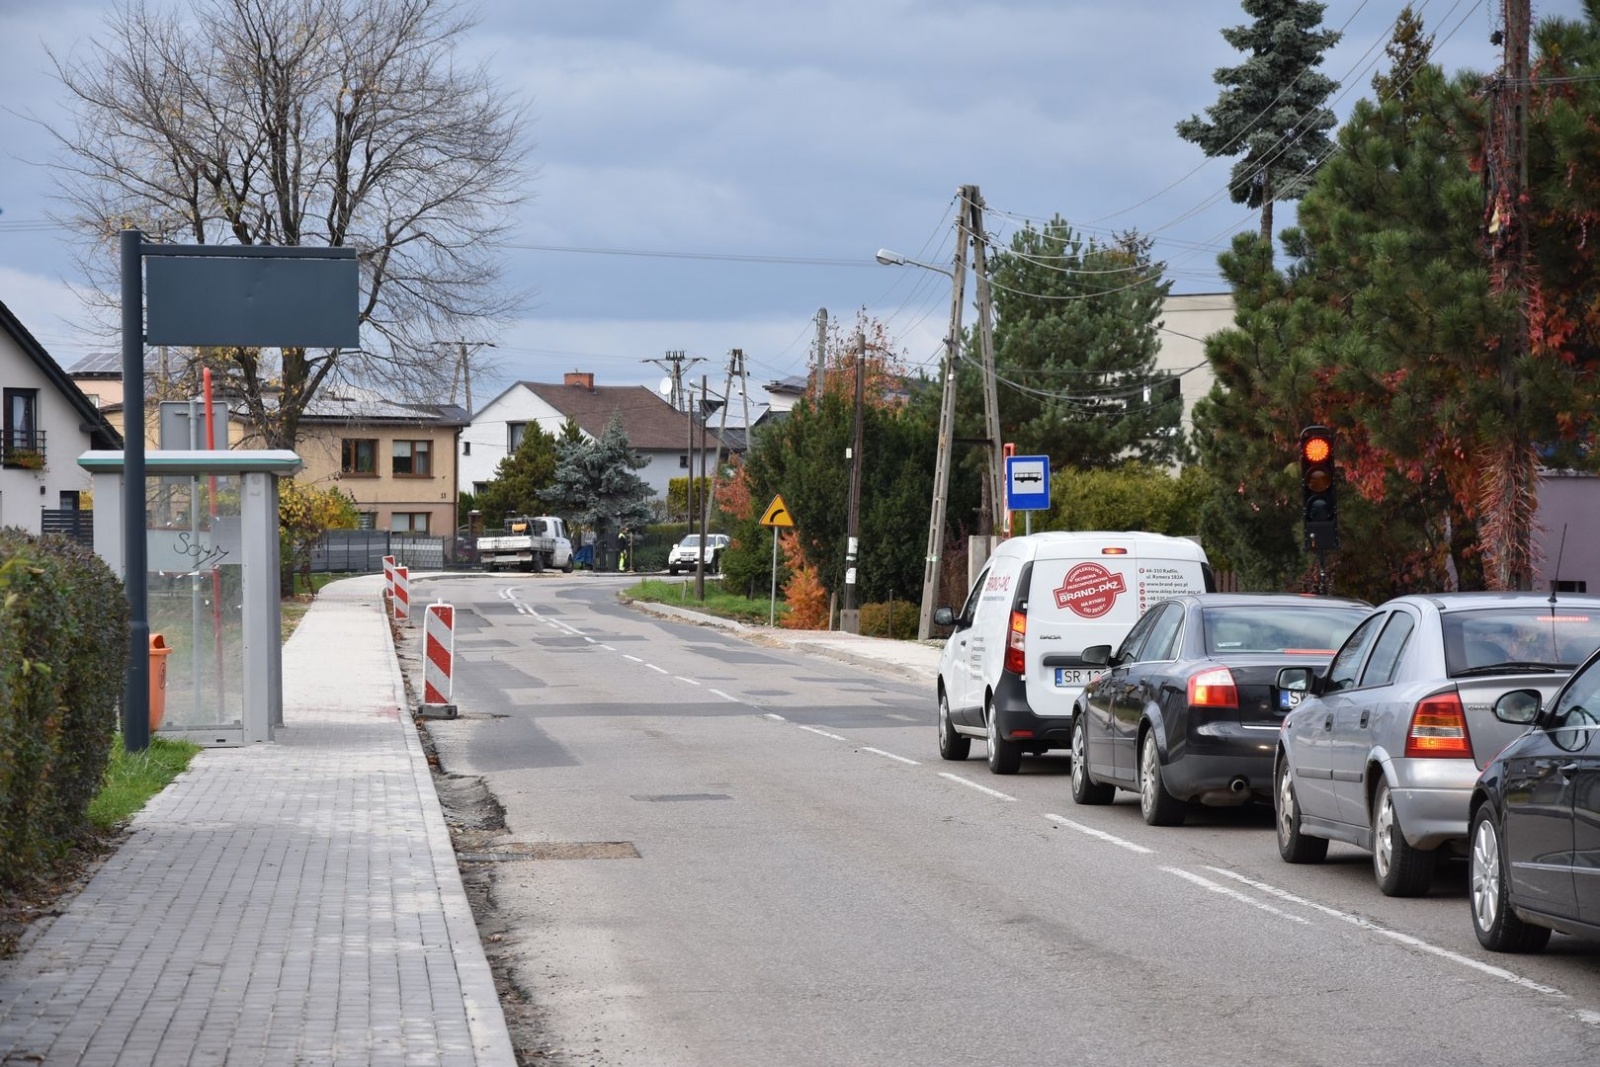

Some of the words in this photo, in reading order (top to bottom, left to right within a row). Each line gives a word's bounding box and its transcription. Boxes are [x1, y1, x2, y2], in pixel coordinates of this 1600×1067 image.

[1069, 566, 1103, 582] KOMPLEKSOWA
[1074, 573, 1097, 582] OCHRONA
[1064, 670, 1081, 683] SR
